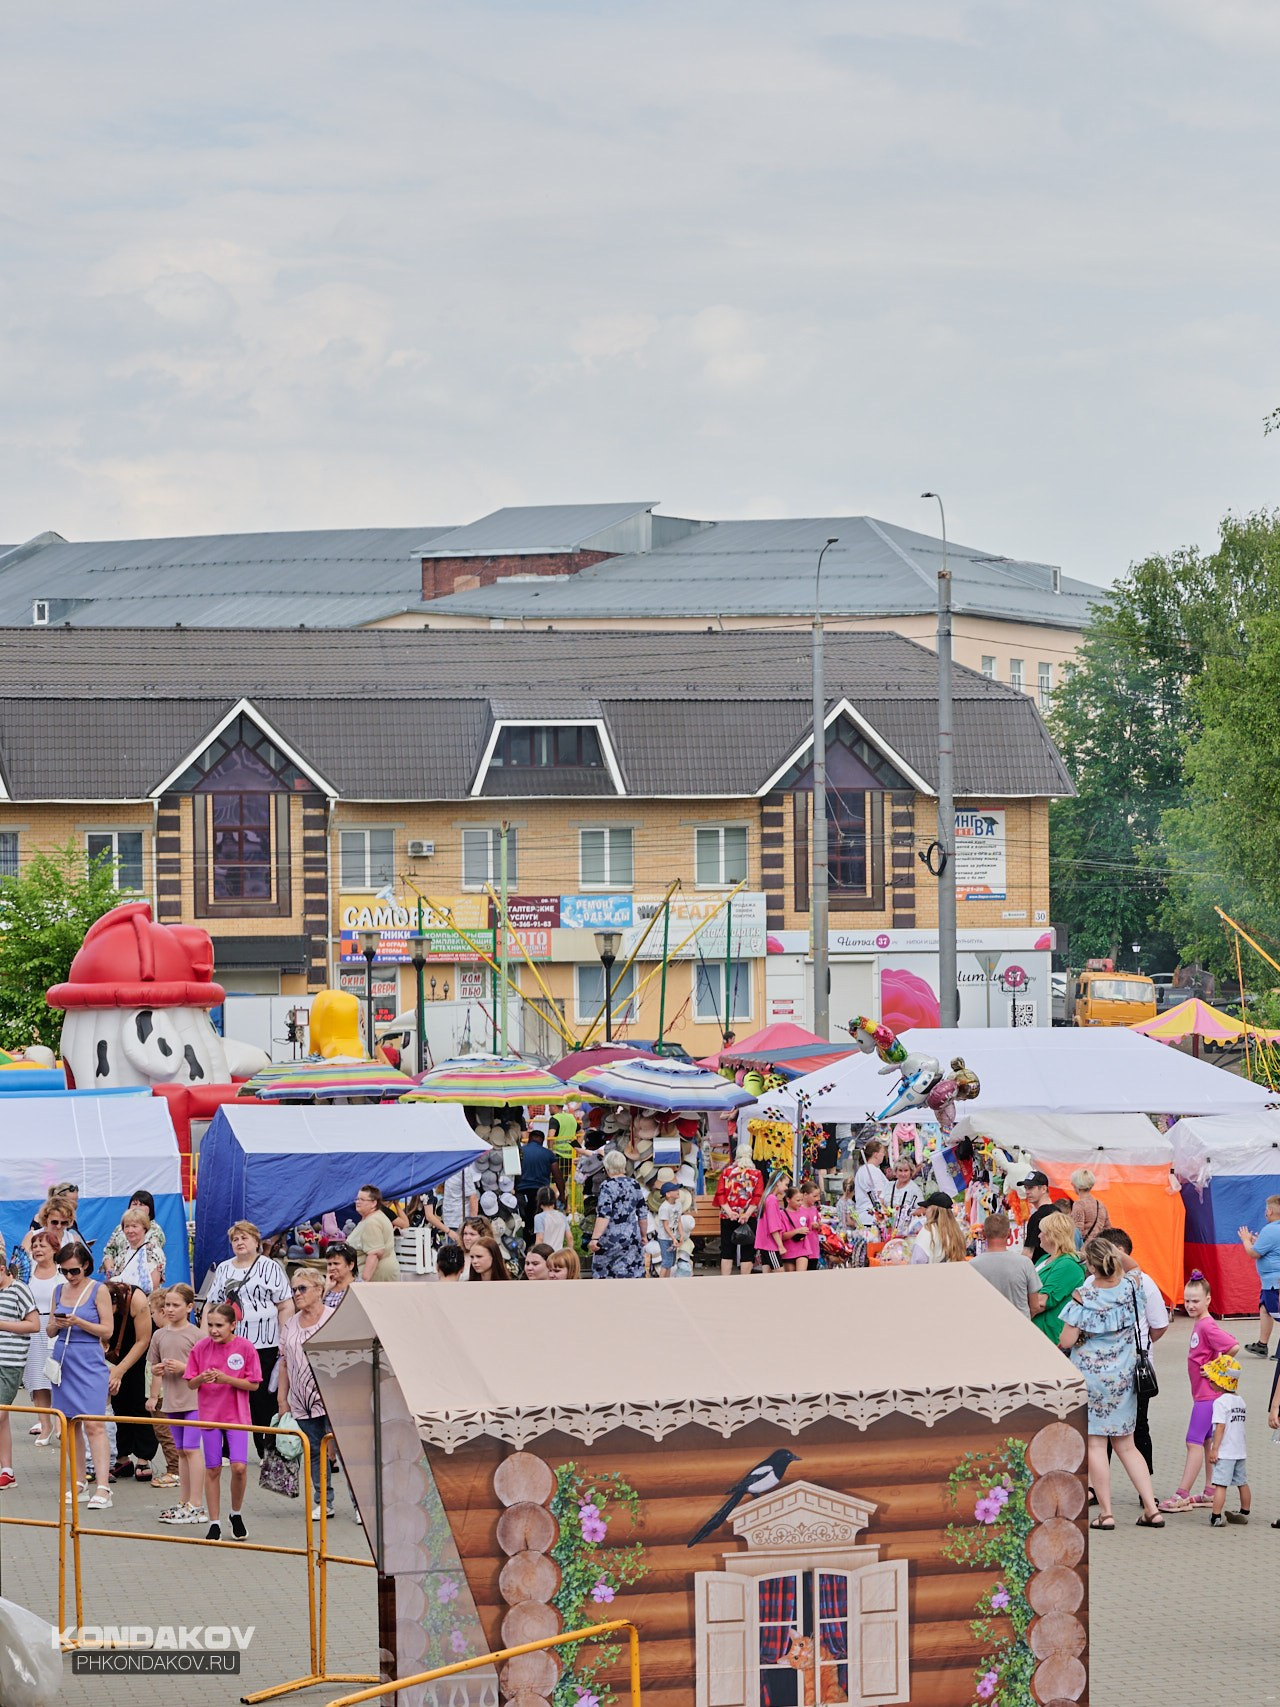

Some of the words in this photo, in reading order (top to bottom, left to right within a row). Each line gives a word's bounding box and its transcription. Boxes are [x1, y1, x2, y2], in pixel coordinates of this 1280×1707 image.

[955, 815, 995, 836] ИНГВА
[576, 900, 614, 910] РЕМОНТ
[583, 911, 630, 922] ОДЕЖДЫ
[1035, 912, 1046, 920] 30
[352, 931, 411, 940] ПТНИКИ
[702, 928, 761, 937] СТОМАОЛОГИЯ
[837, 936, 875, 947] Нитки
[878, 938, 887, 946] 37
[341, 976, 365, 986] ОКНА
[462, 973, 481, 983] КОМ
[371, 982, 396, 995] ДВЕРИ
[462, 986, 482, 996] ПЬЮ
